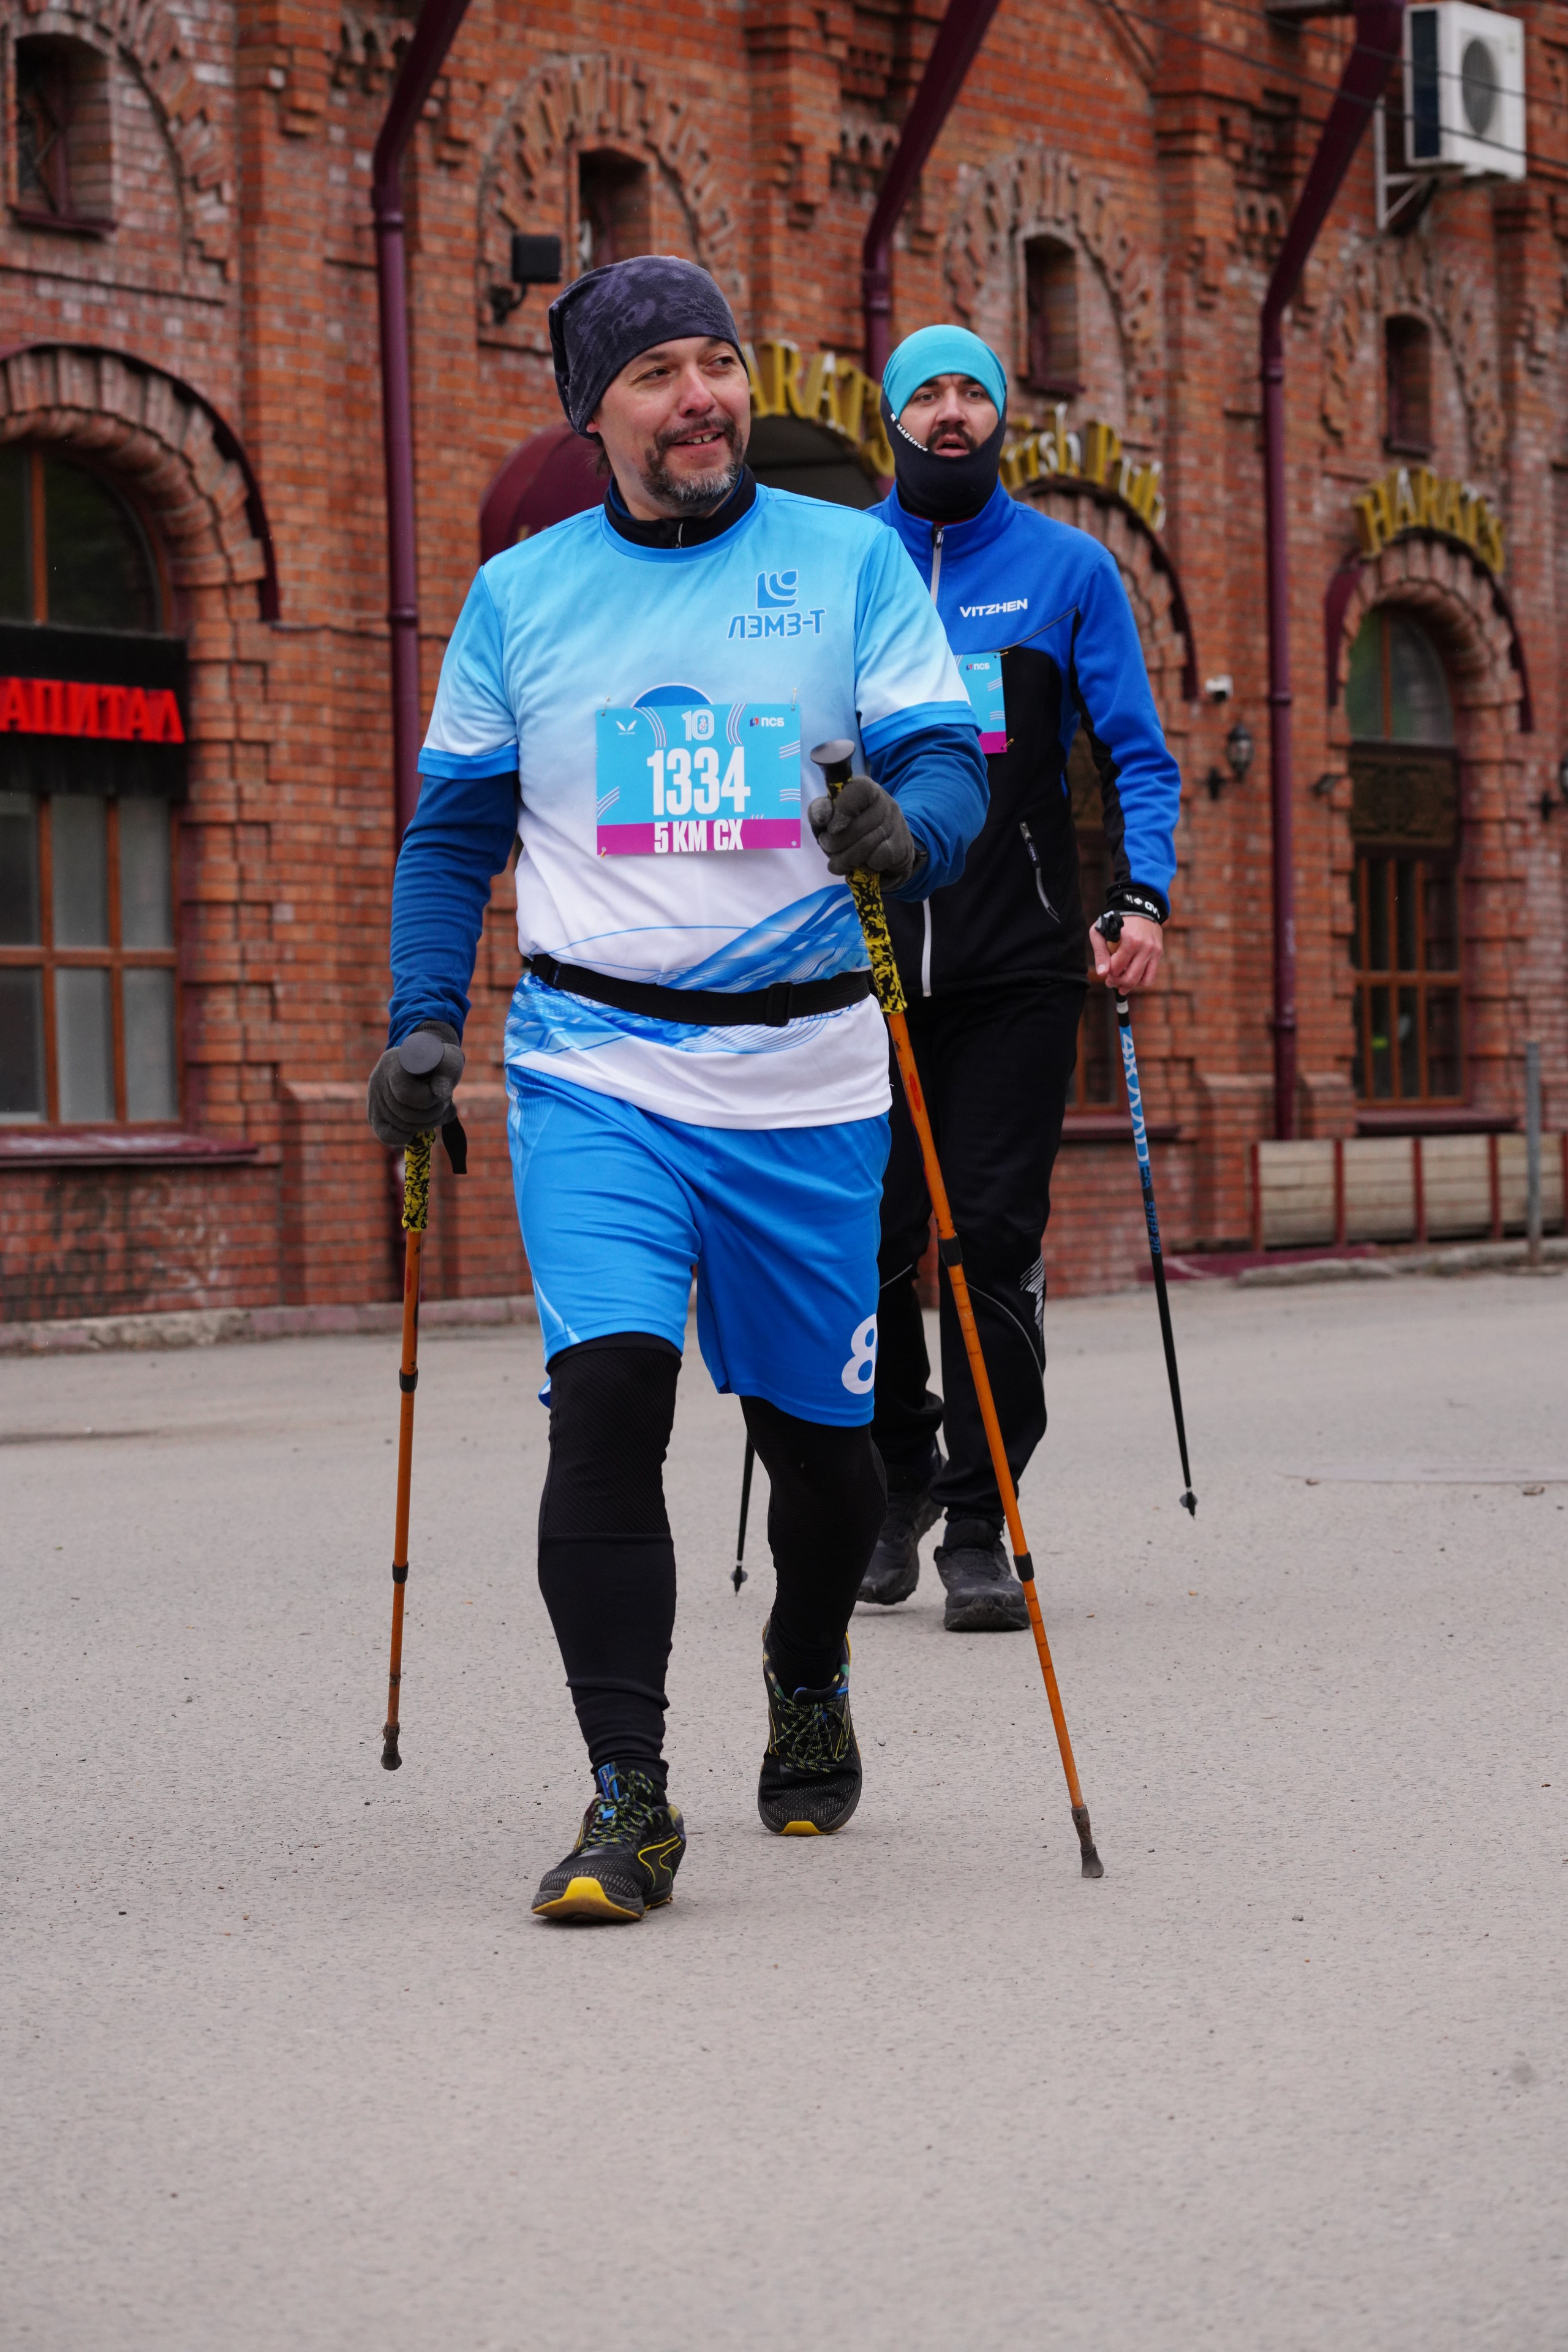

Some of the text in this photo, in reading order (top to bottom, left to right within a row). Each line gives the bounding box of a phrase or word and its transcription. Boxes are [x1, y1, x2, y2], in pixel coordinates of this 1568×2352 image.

[959, 598, 1028, 617] VITZHEN
[727, 609, 827, 640] ЛЭМЗ-Т
[974, 662, 990, 671] ПСБ
[681, 709, 715, 741] 10
[761, 717, 785, 728] ПСБ
[647, 746, 751, 816] 1334
[654, 822, 669, 853] 5
[842, 1313, 878, 1395] 8
